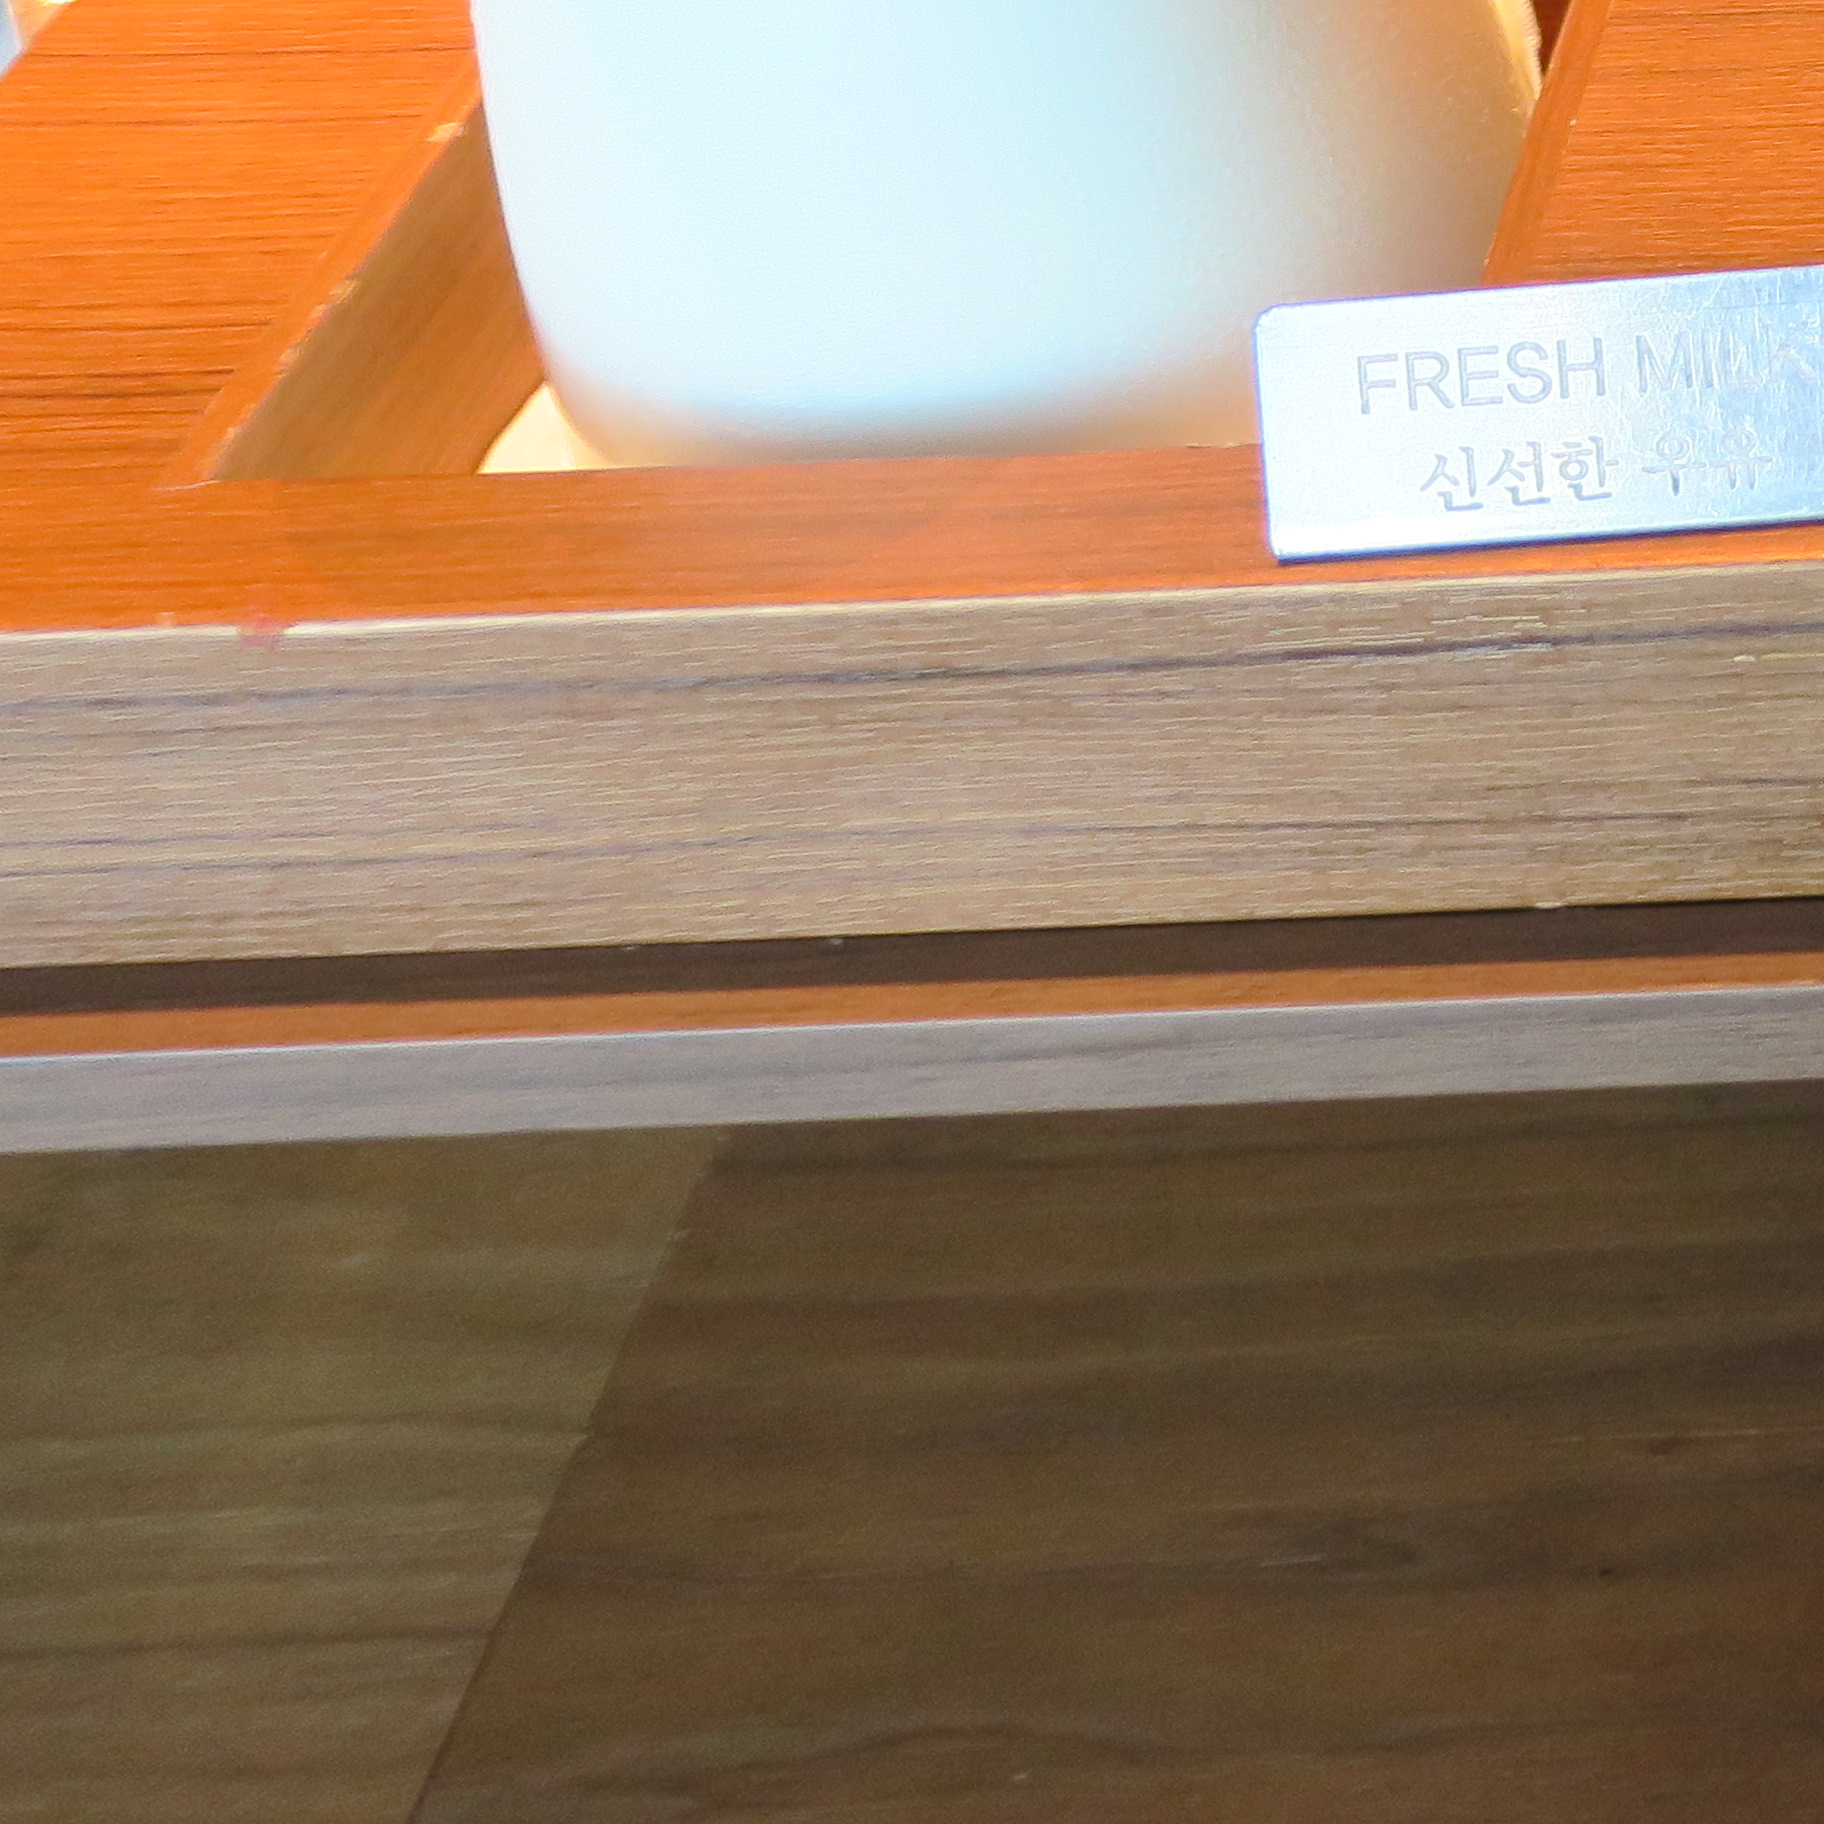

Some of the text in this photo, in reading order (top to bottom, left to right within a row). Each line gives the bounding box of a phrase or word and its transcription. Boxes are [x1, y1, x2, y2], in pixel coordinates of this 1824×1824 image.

[1355, 321, 1821, 416] FRESH MILK
[1420, 429, 1774, 514] 신선한 우유
